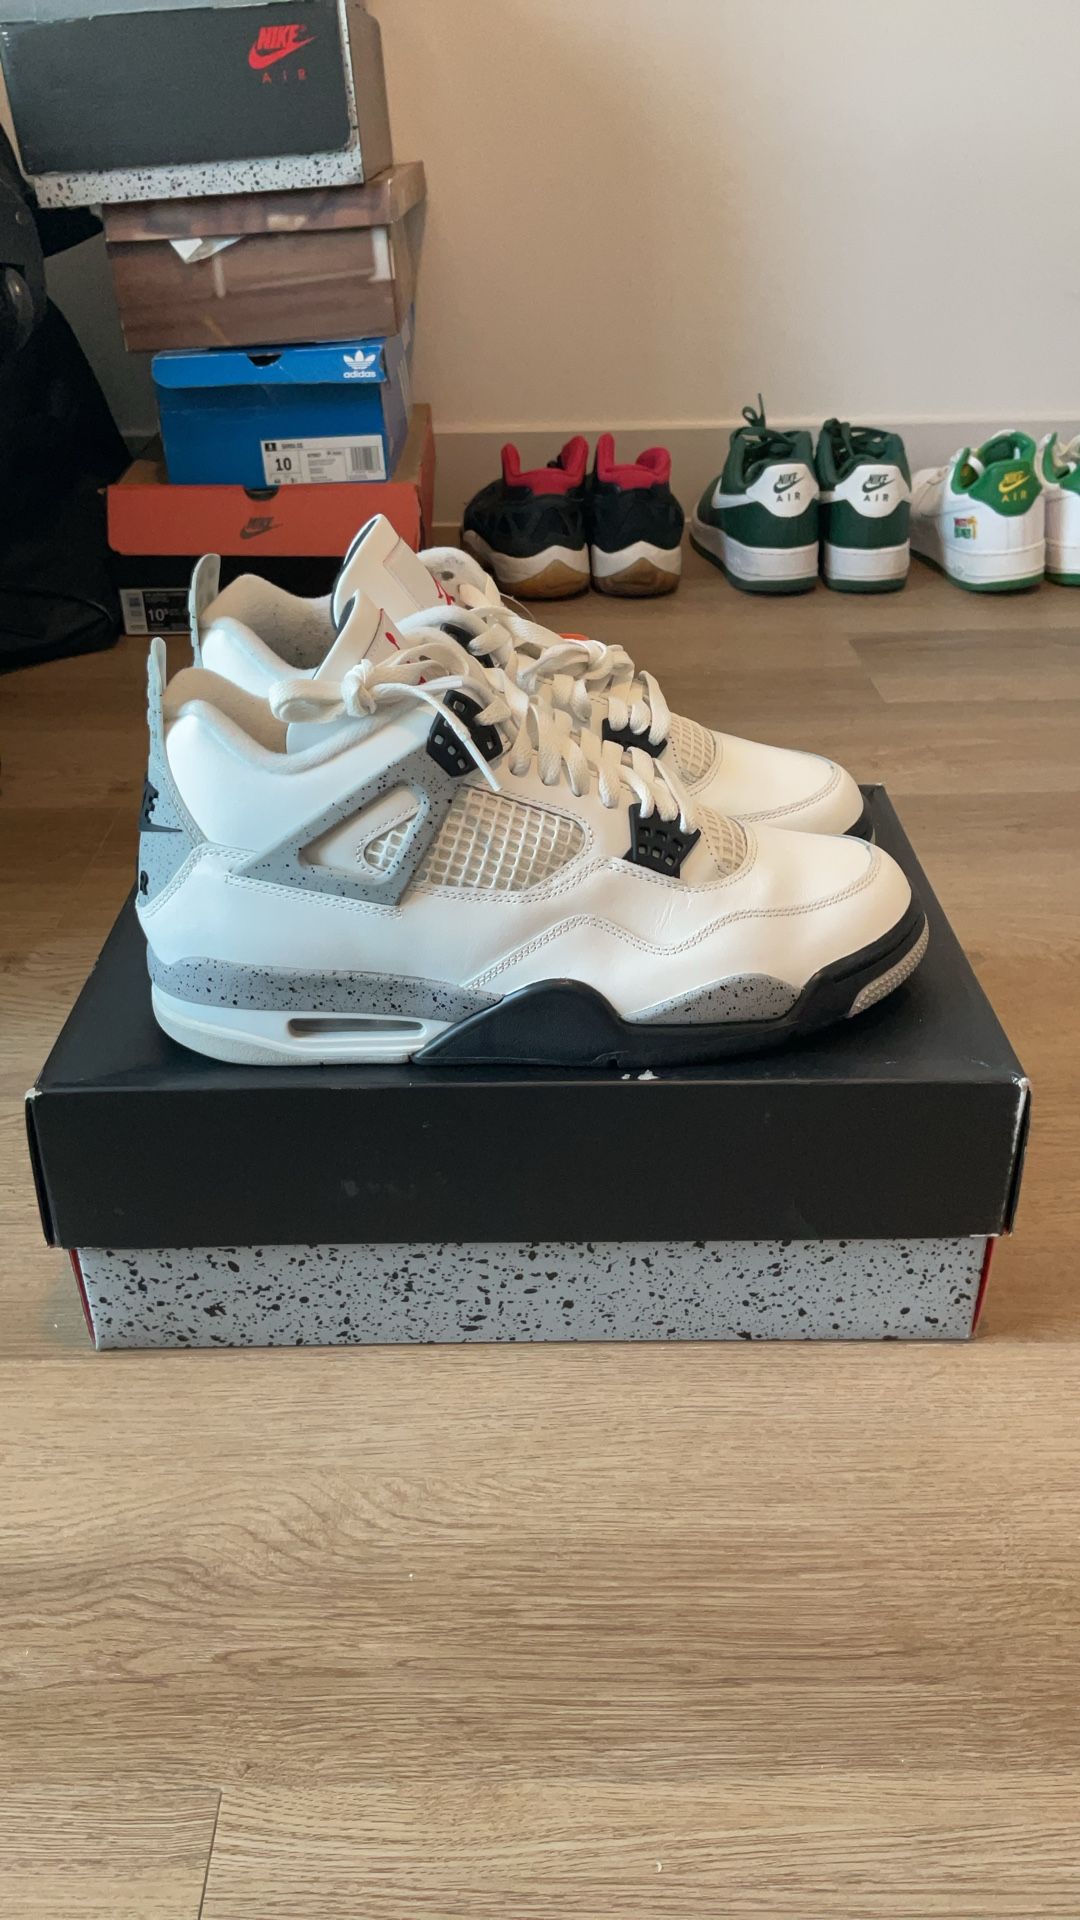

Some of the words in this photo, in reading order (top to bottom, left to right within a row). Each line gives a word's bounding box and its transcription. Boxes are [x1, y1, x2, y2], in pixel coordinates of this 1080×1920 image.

[257, 25, 299, 49] NIKE
[262, 68, 307, 84] AIR
[343, 370, 377, 379] adidas
[275, 457, 292, 472] 10
[780, 472, 798, 484] NIKE
[869, 474, 889, 484] NIKE
[776, 492, 802, 502] AIR
[864, 494, 890, 502] AIR
[1002, 489, 1027, 503] AIR
